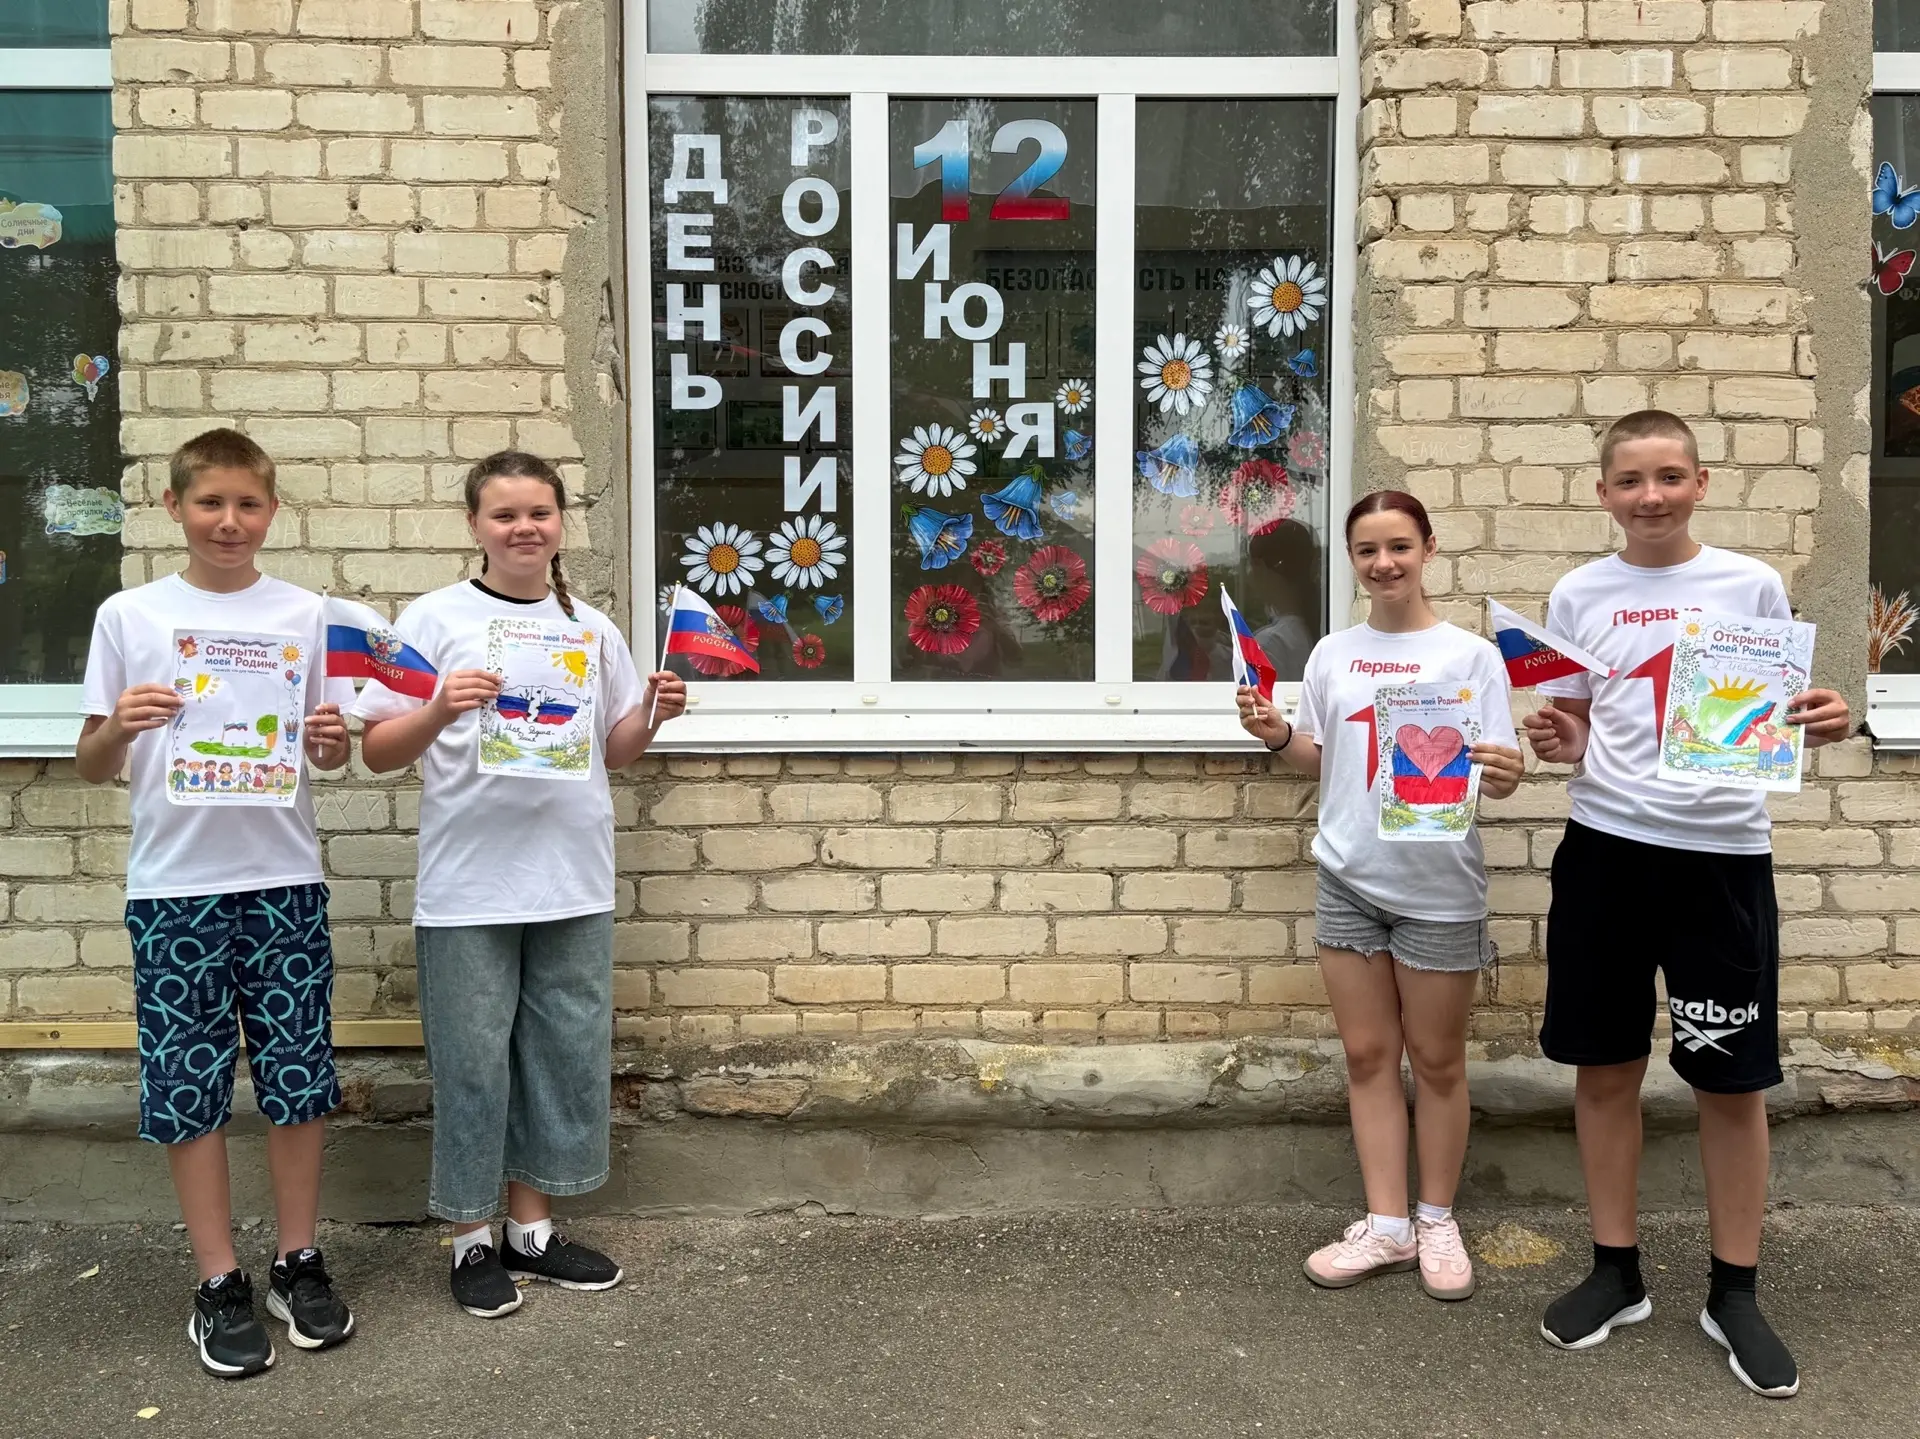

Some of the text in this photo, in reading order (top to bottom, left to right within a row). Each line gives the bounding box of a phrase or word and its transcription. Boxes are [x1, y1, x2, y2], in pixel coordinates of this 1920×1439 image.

[913, 118, 1070, 222] 12
[0, 218, 48, 228] Солнечные
[664, 134, 729, 410] ДЕНЬ
[779, 108, 839, 512] РОССИИ
[896, 222, 1055, 459] ИЮНЯ
[1613, 607, 1703, 627] Перв
[503, 629, 586, 645] Открытка моей Родине
[692, 635, 737, 653] РОССИЯ
[1713, 630, 1780, 648] Открытка
[205, 645, 268, 659] Открытка
[1710, 643, 1782, 659] моей Родине
[204, 656, 278, 670] моей Родине
[364, 657, 405, 680] РОССИЯ
[1349, 659, 1421, 678] Первые
[1387, 696, 1463, 708] Открытка моей Родине
[196, 921, 230, 935] Calvin Klein
[1669, 996, 1760, 1026] eebok
